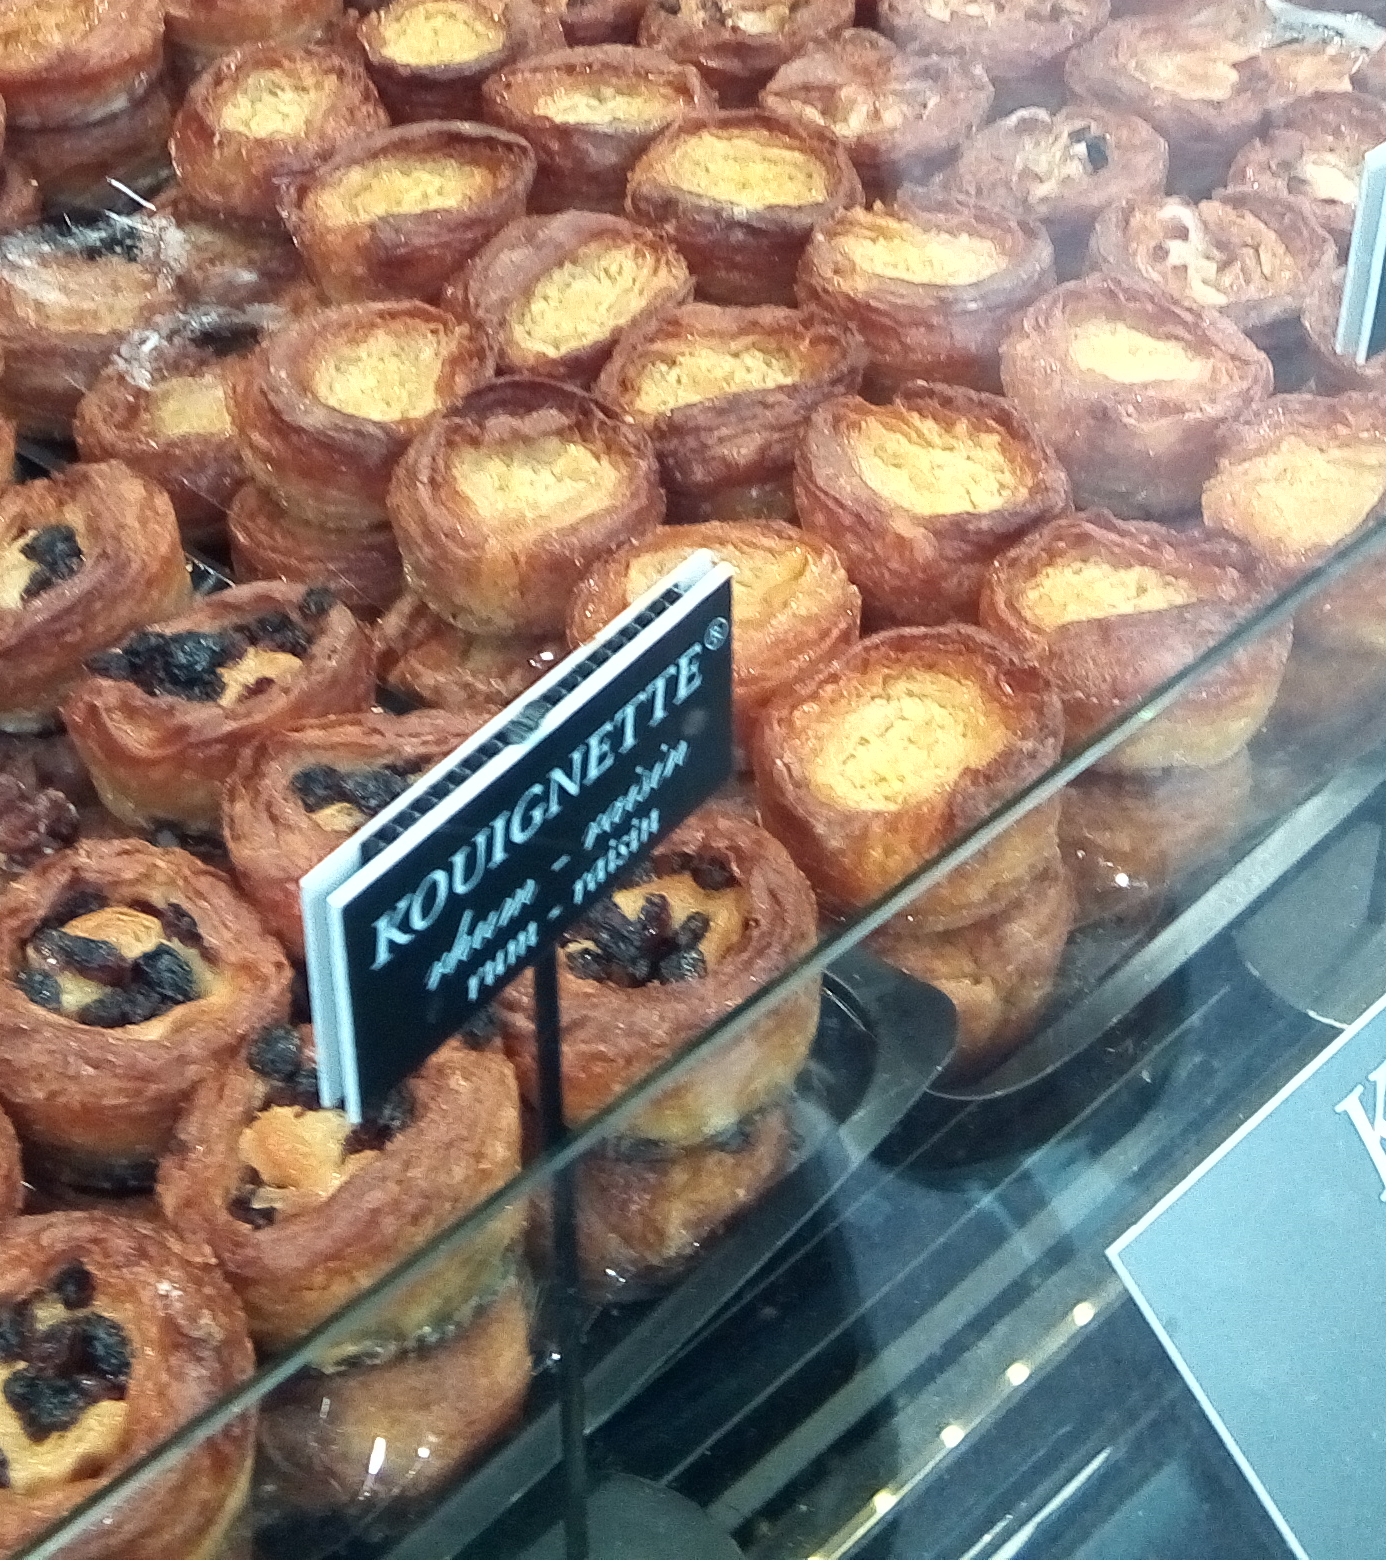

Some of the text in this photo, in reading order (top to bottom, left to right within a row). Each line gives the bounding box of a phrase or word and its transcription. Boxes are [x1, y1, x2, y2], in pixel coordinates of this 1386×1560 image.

[426, 878, 538, 991] rhum
[583, 739, 689, 850] raisin
[467, 920, 539, 1002] rum
[573, 807, 661, 904] raisin
